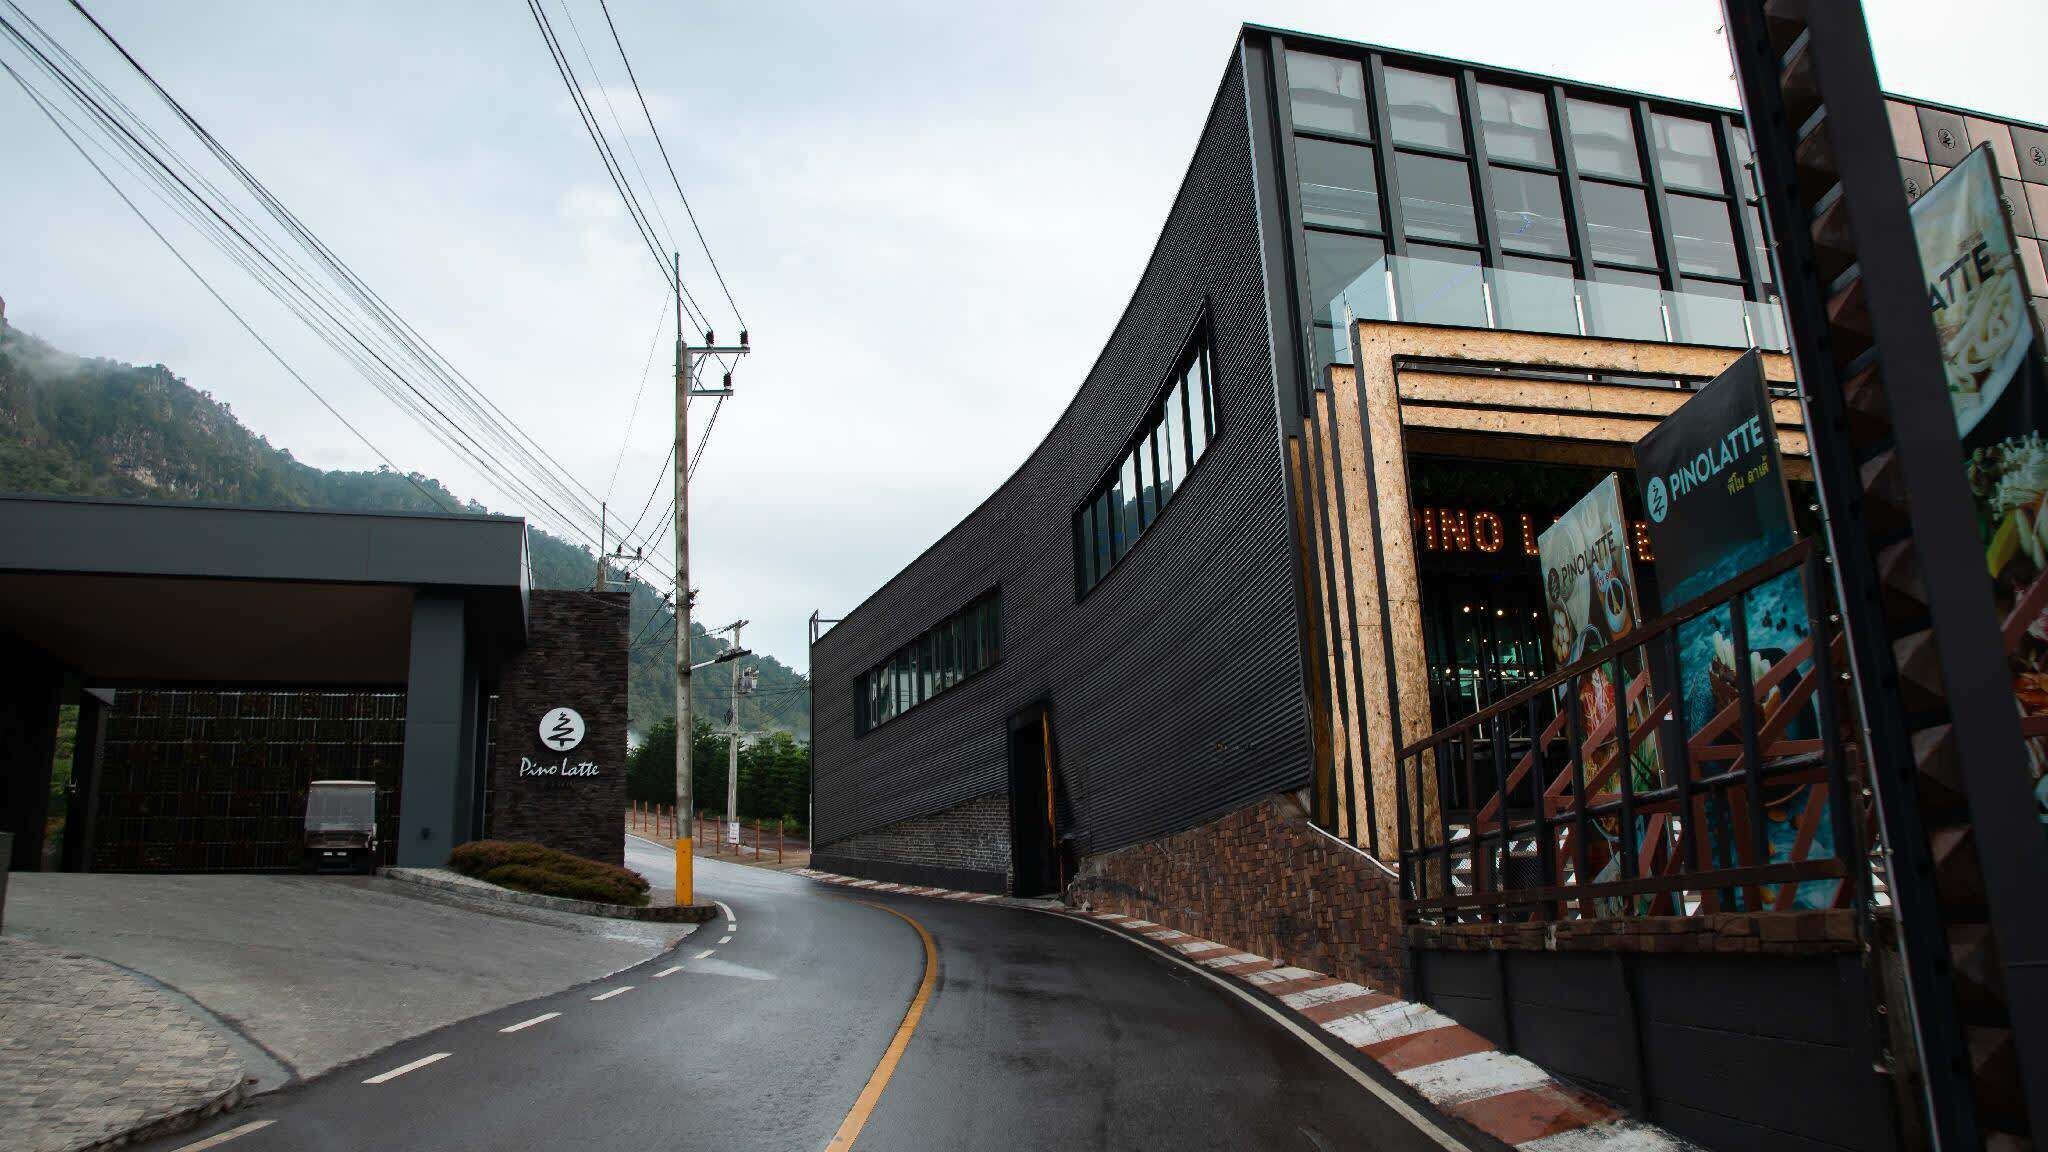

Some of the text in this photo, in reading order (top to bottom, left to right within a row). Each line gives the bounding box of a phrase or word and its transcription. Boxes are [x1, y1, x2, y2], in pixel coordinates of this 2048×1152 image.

[1669, 414, 1765, 501] PINOLATTE
[1561, 529, 1616, 590] PINOLATTE
[519, 756, 600, 777] Pino Latte
